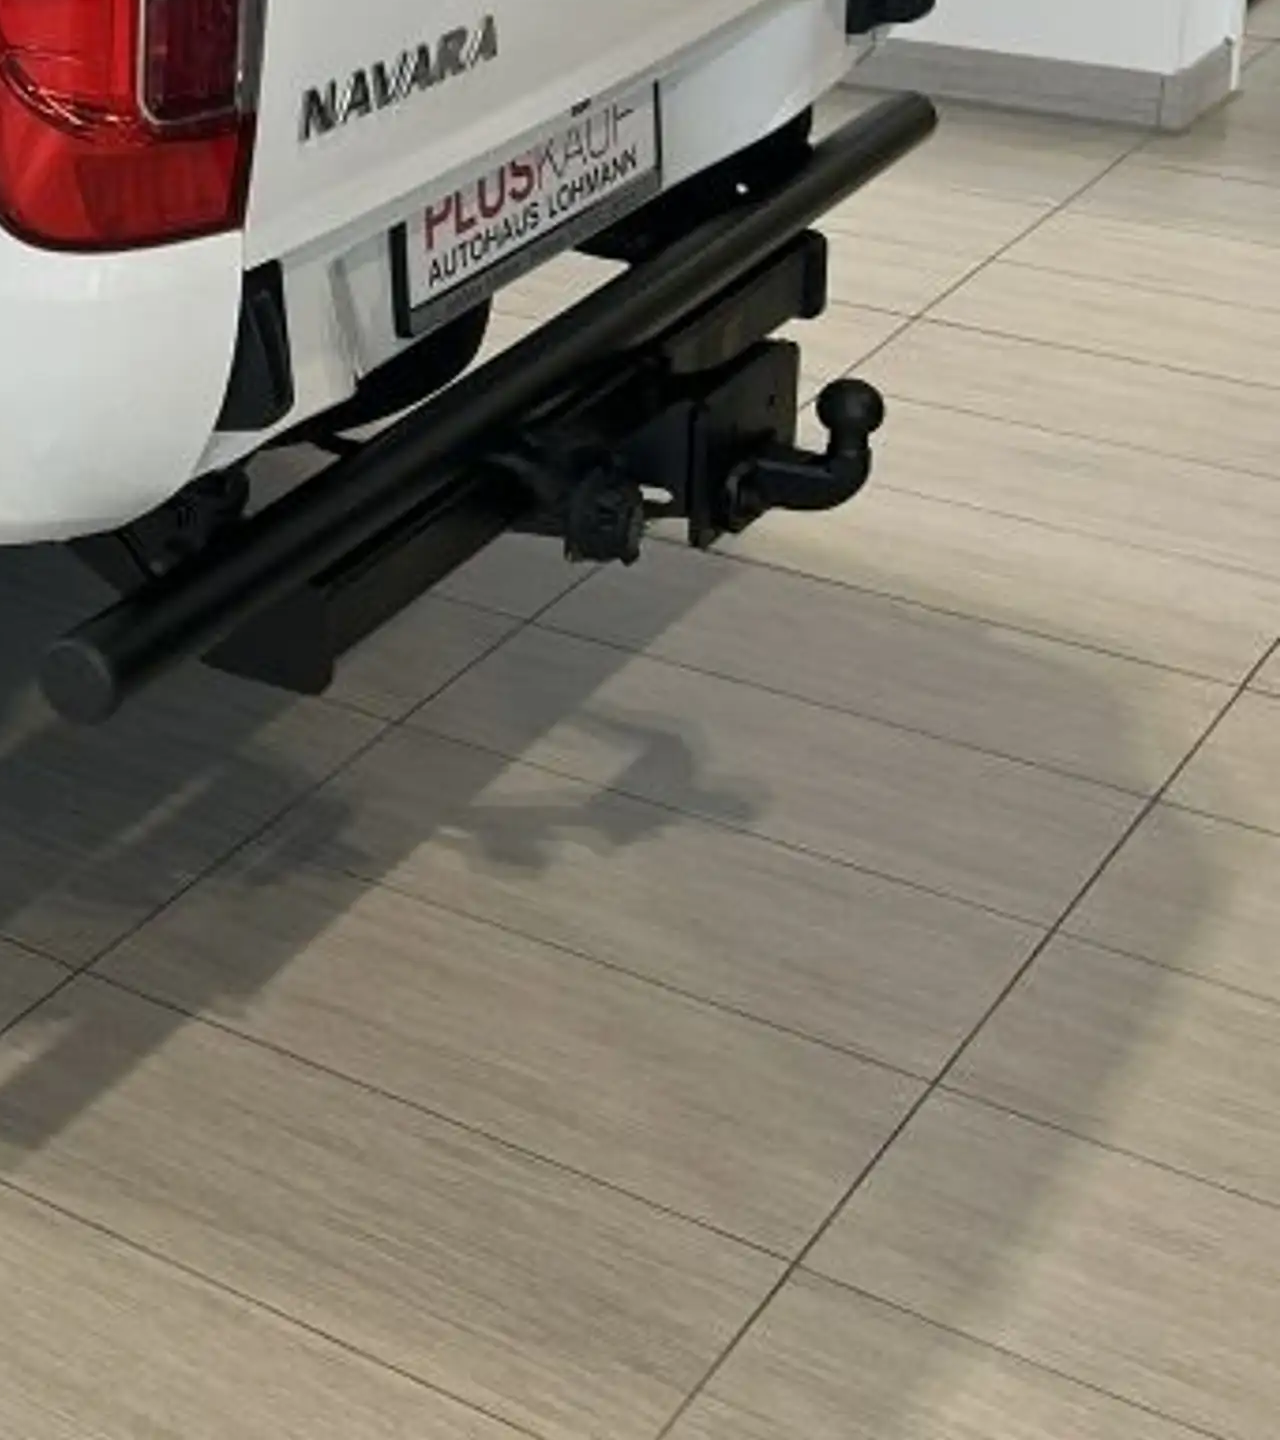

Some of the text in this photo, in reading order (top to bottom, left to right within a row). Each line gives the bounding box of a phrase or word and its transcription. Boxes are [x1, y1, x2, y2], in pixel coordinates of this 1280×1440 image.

[297, 13, 498, 142] NAVARA
[428, 201, 540, 288] AUTOHAUS
[547, 144, 638, 219] LOHMANN
